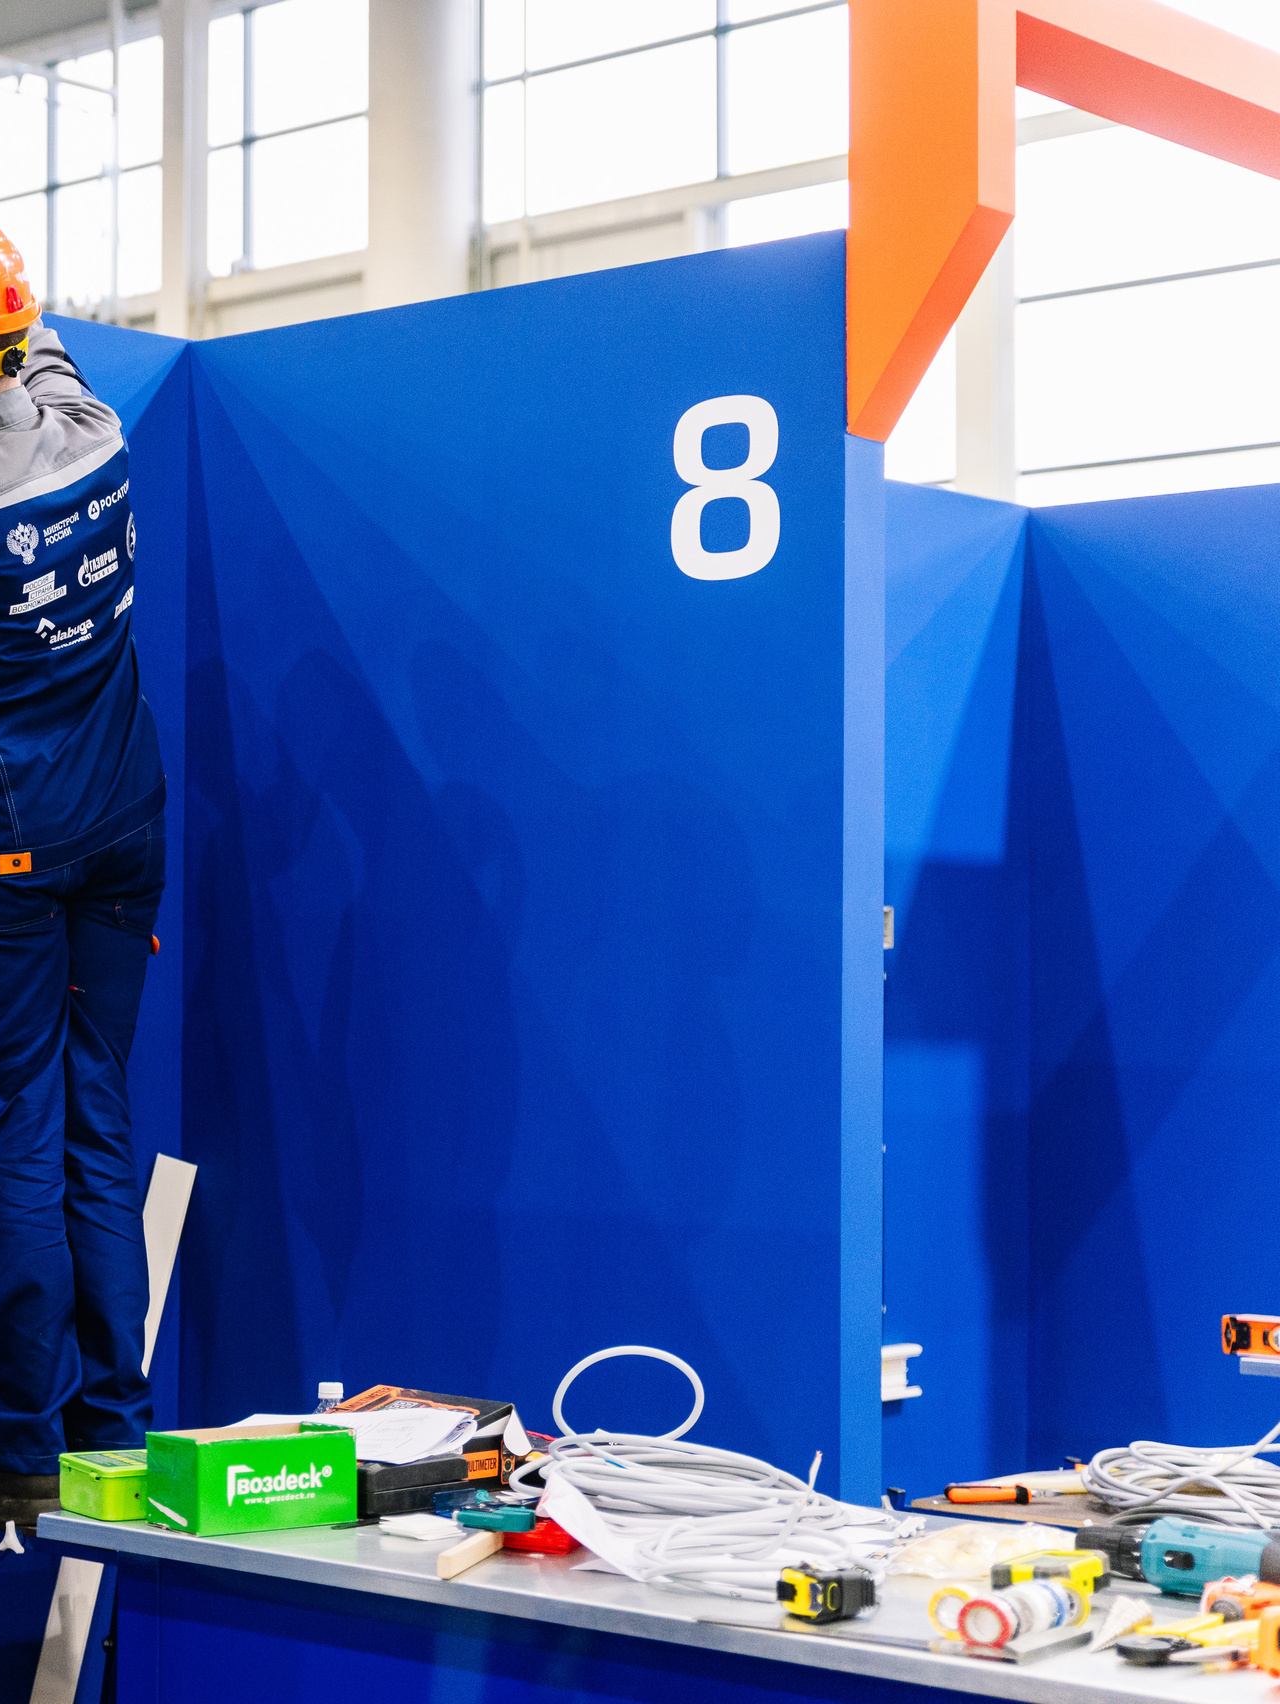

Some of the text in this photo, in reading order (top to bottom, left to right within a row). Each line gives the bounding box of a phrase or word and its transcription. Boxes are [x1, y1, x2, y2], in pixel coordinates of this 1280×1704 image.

[671, 395, 780, 580] 8
[43, 511, 79, 537] МИНСТРОЙ
[45, 526, 72, 546] РОССИИ
[89, 547, 118, 572] ГАЗПРОМ
[24, 576, 49, 591] РОССИЯ
[30, 584, 53, 600] СТРАНА
[11, 587, 65, 613] ВОЗМОЖНОСТЕЙ
[49, 619, 94, 644] alabuga
[244, 1492, 316, 1505] www.gwozdeck.ru
